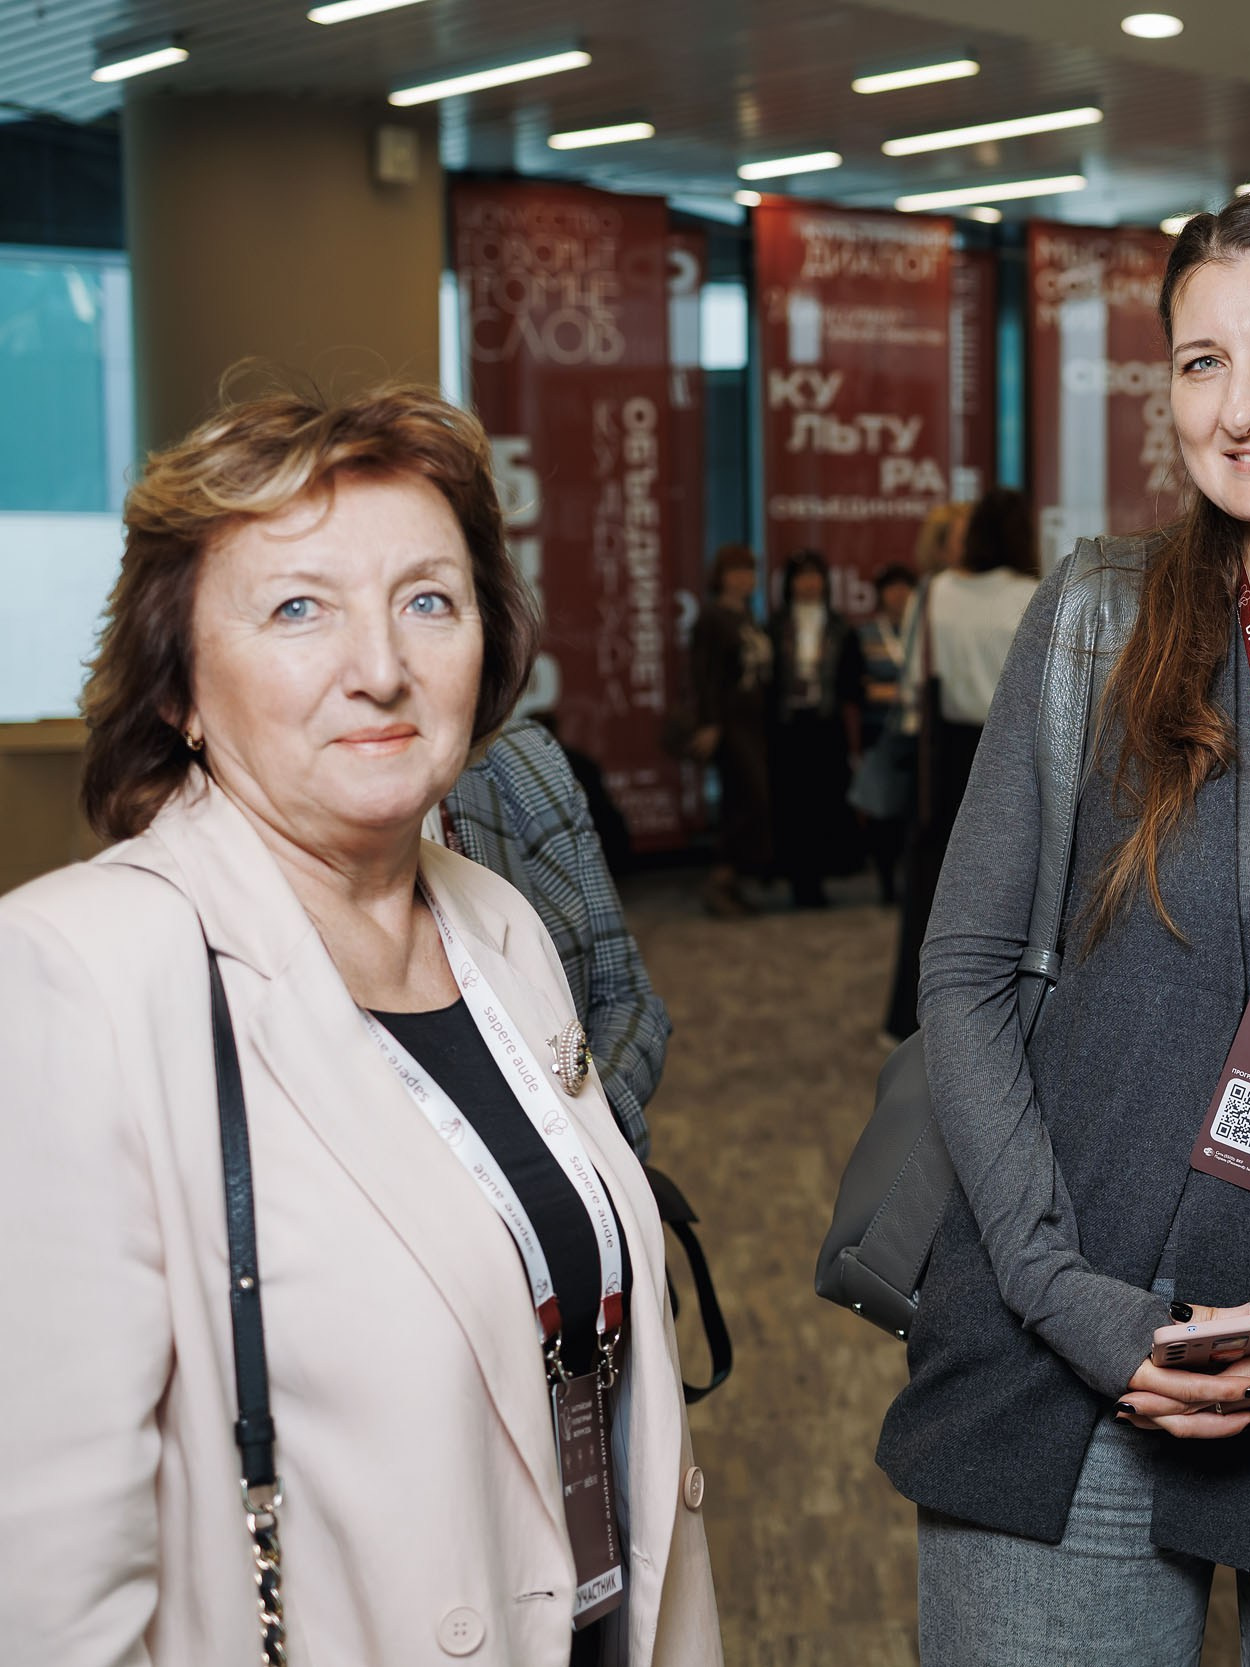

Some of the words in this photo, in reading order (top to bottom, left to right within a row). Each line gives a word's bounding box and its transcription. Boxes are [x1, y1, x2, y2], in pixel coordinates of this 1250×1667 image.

[769, 369, 843, 411] КУ
[788, 413, 923, 455] ЛЬТУ
[880, 457, 947, 497] РА
[484, 1006, 517, 1055] sapere
[513, 1057, 539, 1092] aude
[388, 1056, 430, 1102] sapere
[473, 1163, 504, 1199] aude
[570, 1155, 600, 1204] sapere
[598, 1209, 614, 1248] aude
[576, 1573, 617, 1608] УЧАСТНИК
